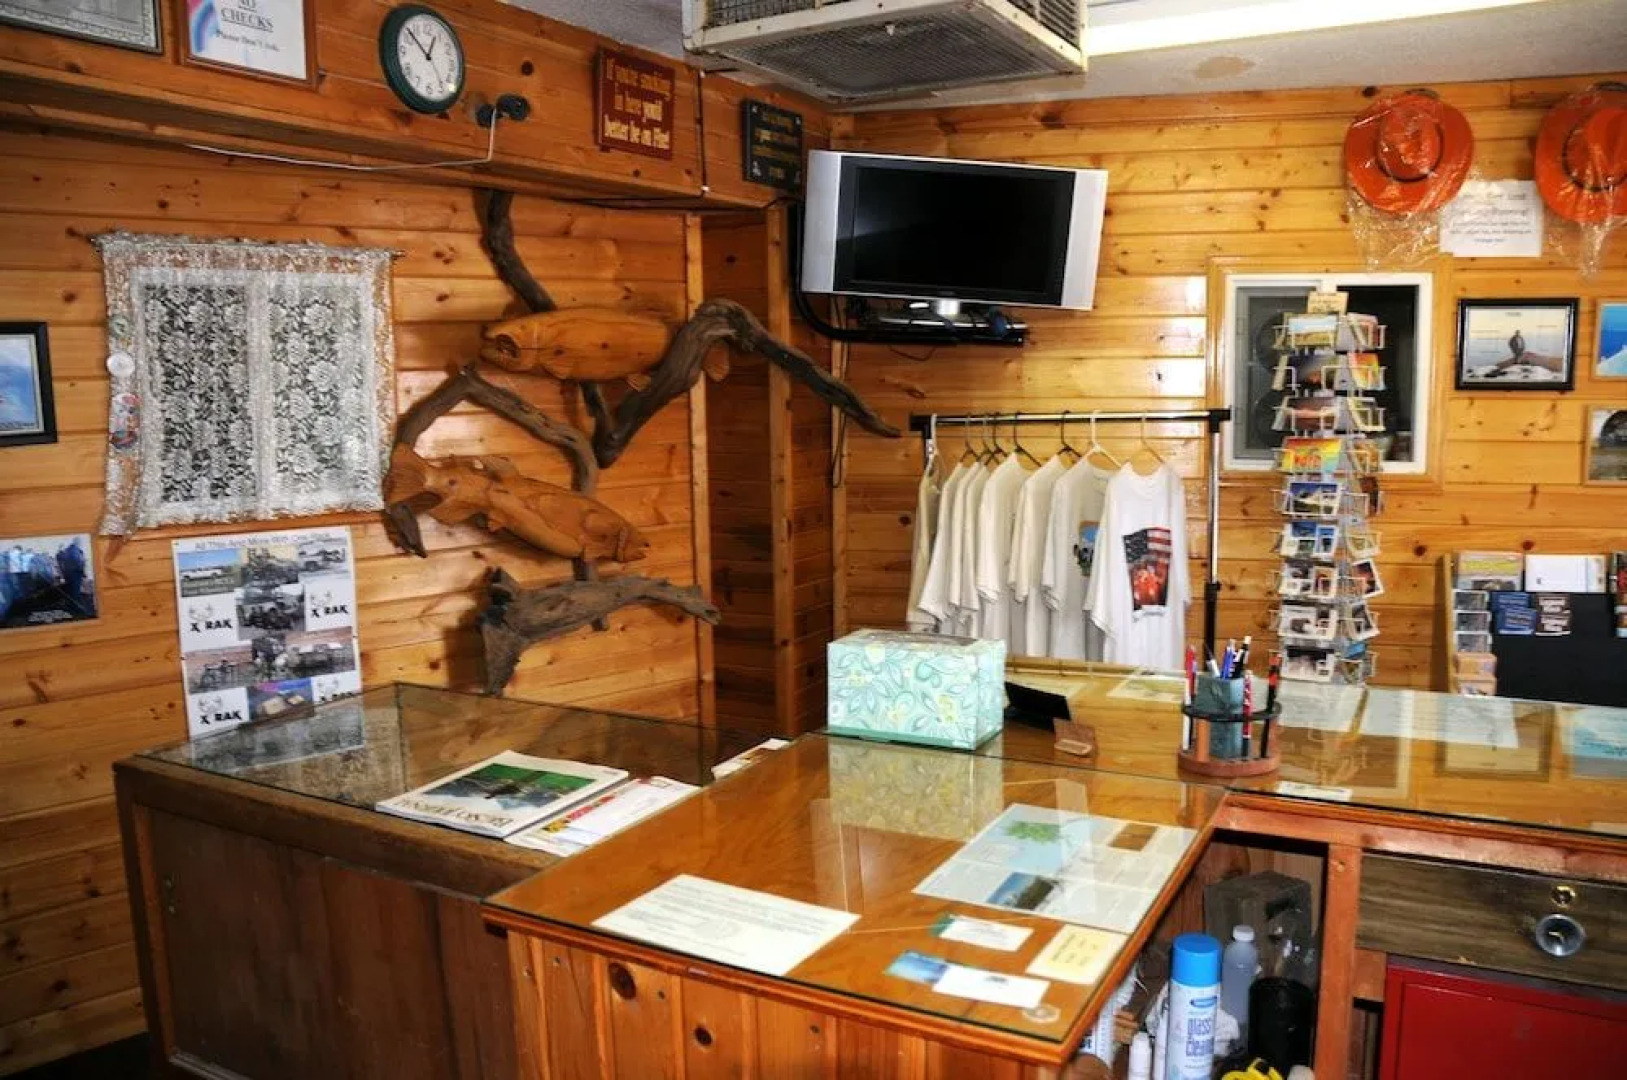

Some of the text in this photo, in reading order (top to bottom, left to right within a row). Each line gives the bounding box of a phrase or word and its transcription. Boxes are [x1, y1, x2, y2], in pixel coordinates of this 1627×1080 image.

[221, 8, 274, 29] CHECKS
[324, 604, 348, 614] RAK
[191, 619, 232, 633] X RAK
[200, 710, 242, 725] X RAK
